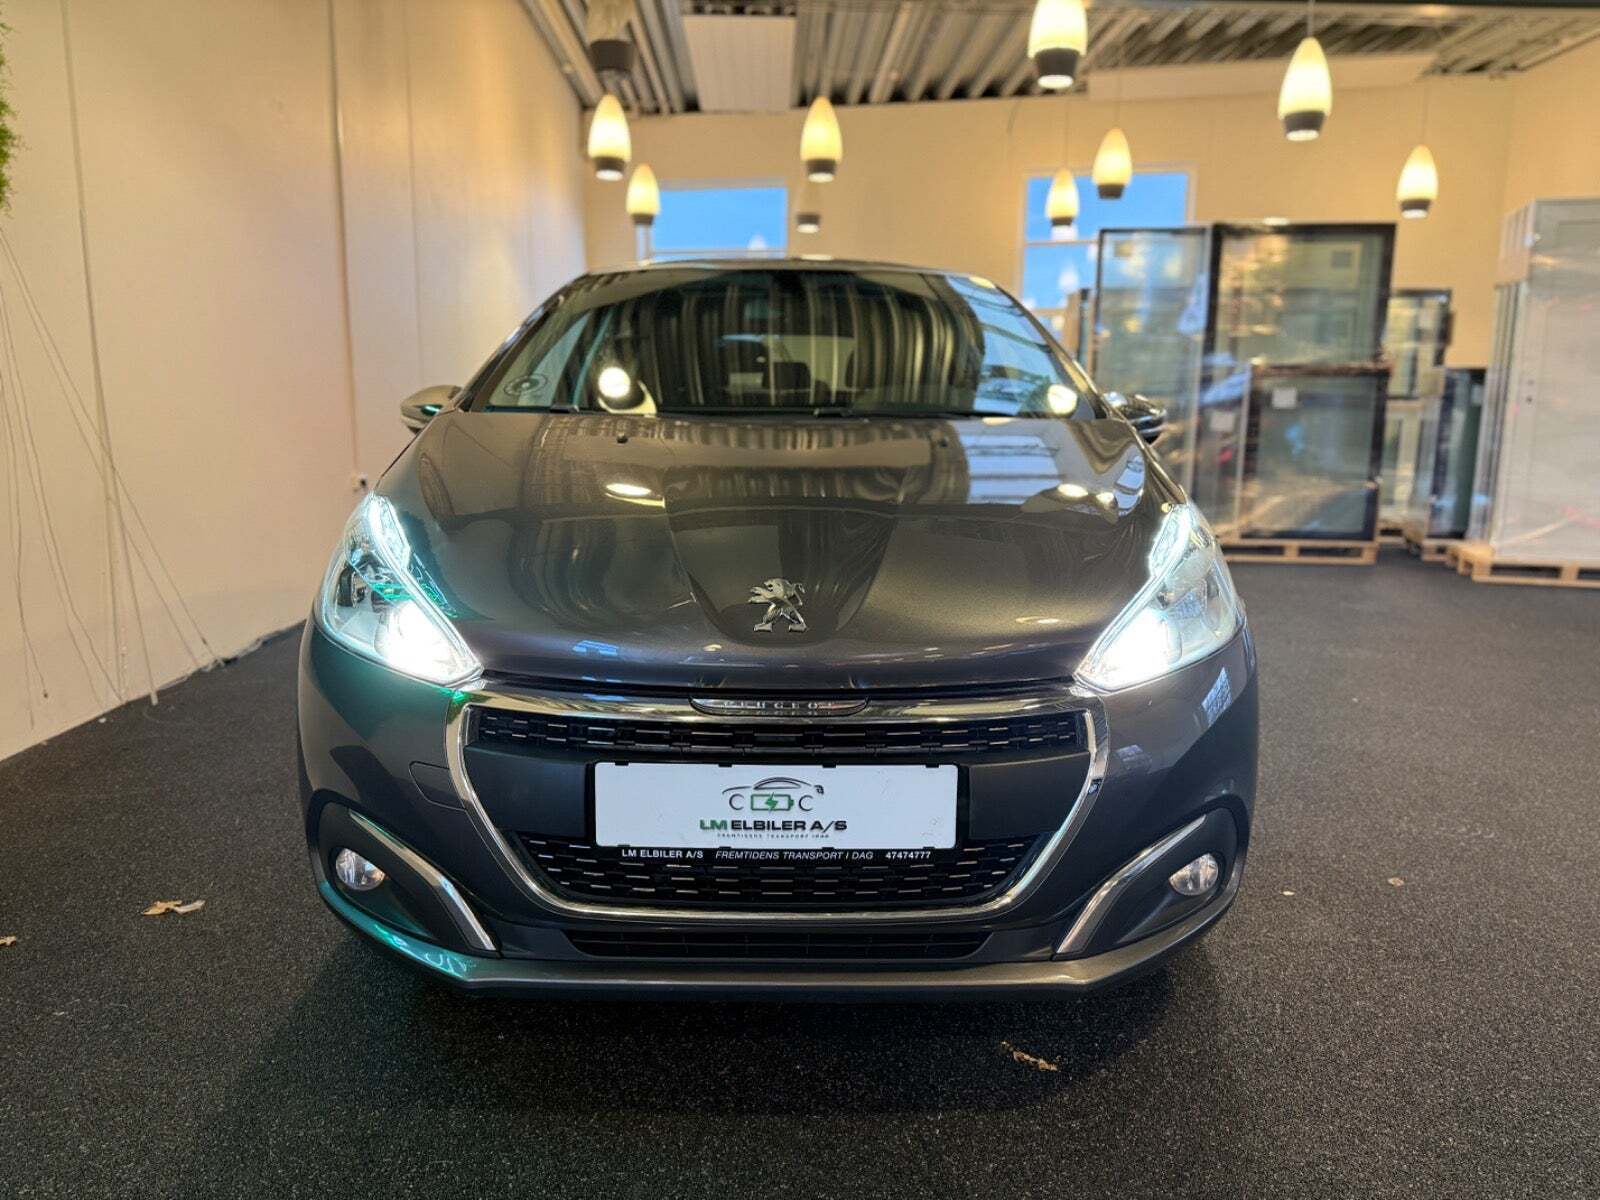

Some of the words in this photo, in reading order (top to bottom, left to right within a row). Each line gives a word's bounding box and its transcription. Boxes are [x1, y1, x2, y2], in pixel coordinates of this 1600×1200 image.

[699, 819, 728, 831] LM
[731, 820, 806, 831] ELBILER
[810, 820, 848, 833] A/S
[621, 848, 637, 858] LM
[640, 849, 683, 859] ELBILER
[685, 850, 704, 859] A/S
[715, 850, 780, 860] FREMTIDENS
[783, 851, 843, 860] TRANSPORT
[852, 851, 874, 860] DAG
[885, 851, 932, 860] 47474777
